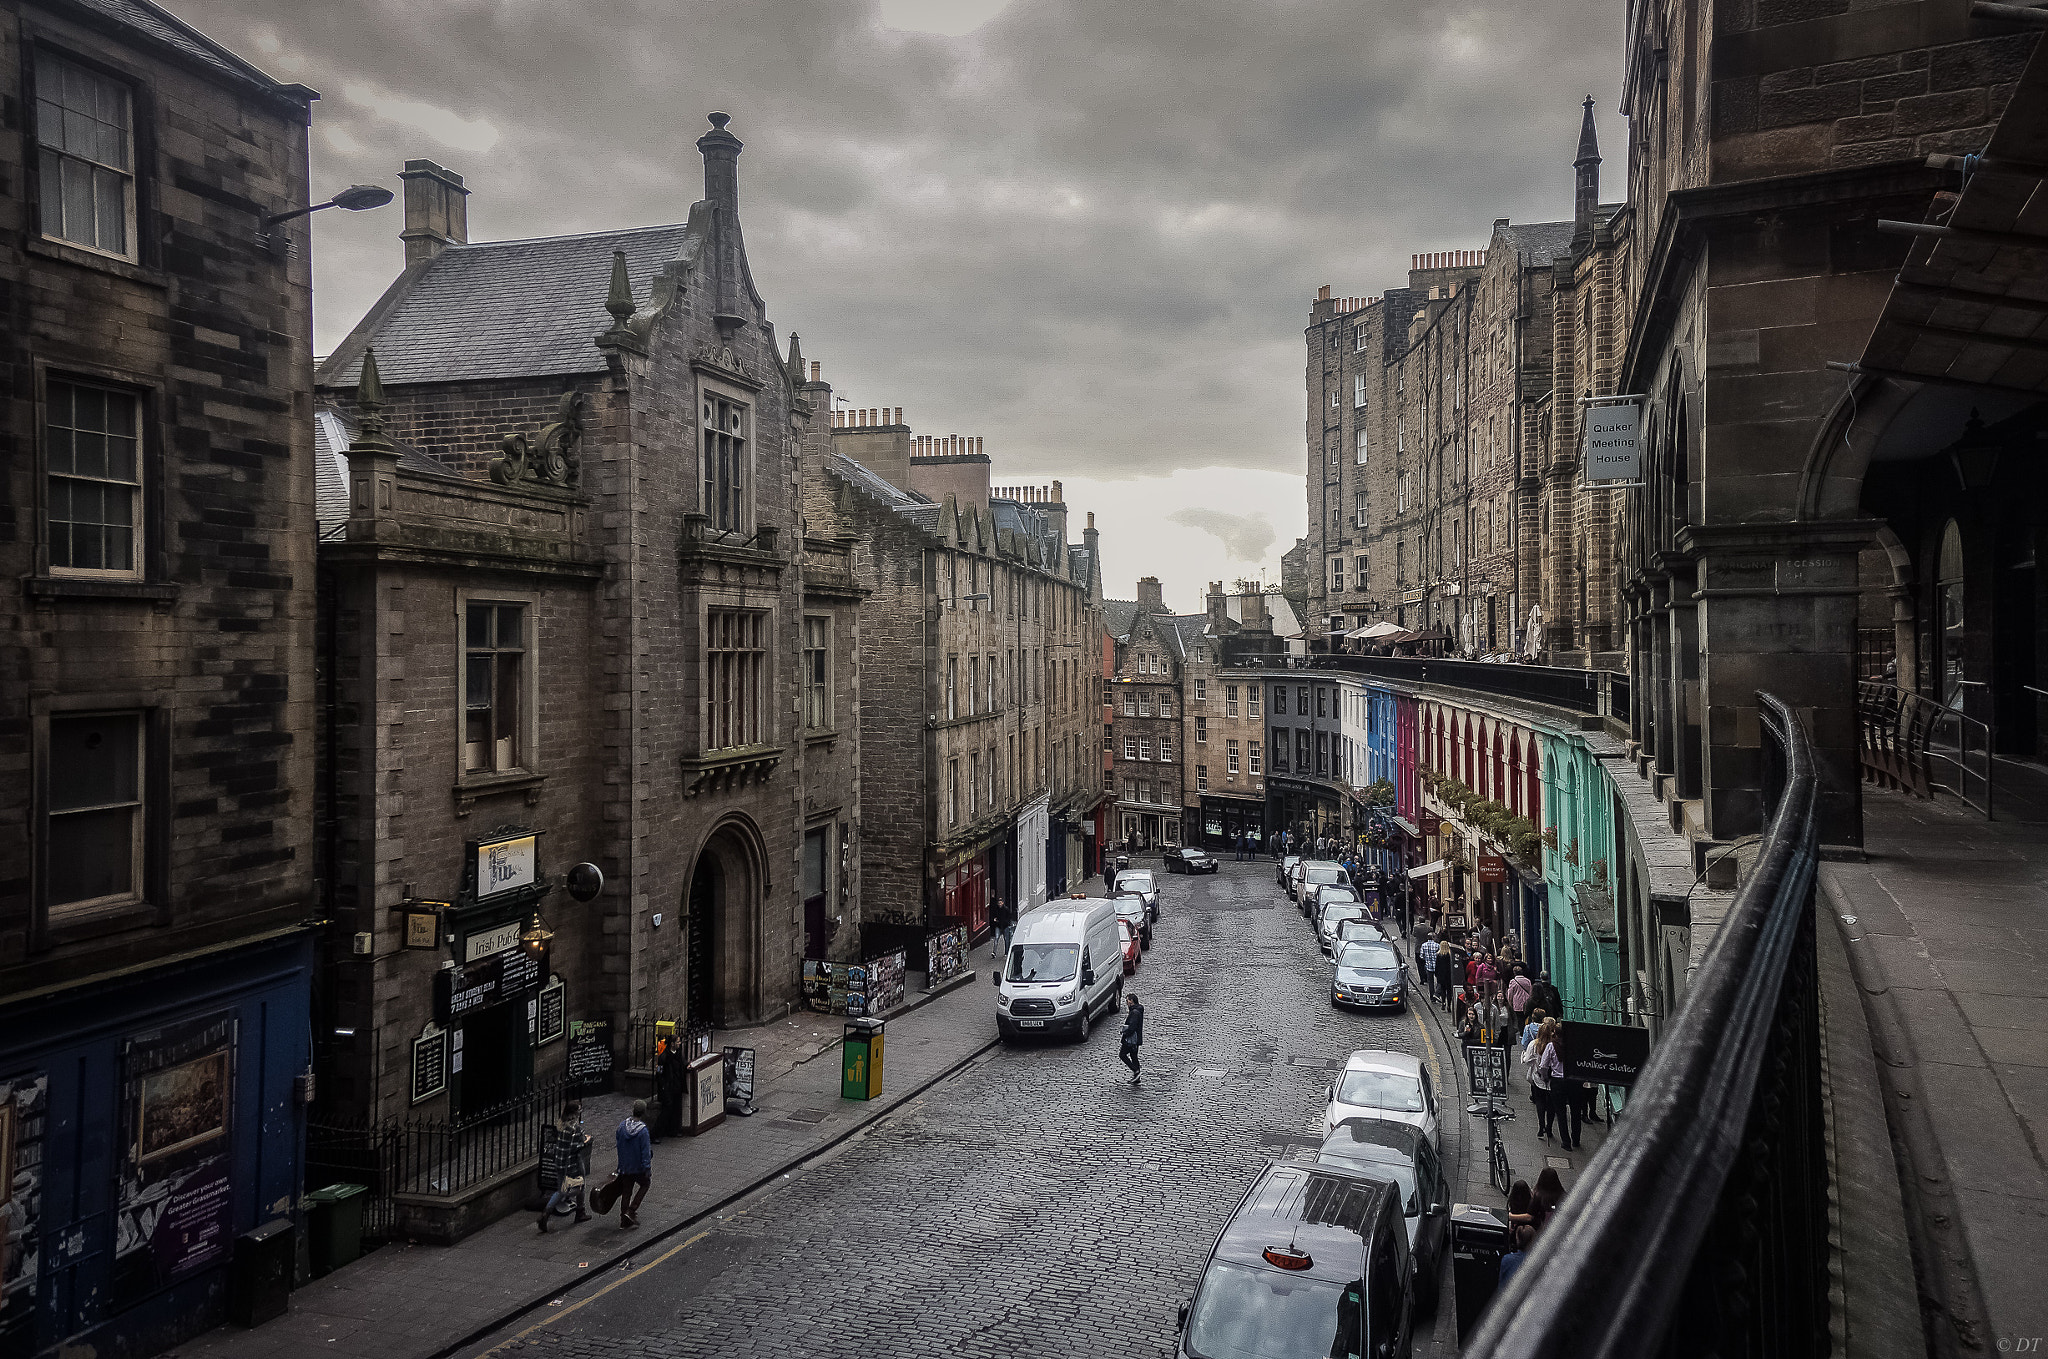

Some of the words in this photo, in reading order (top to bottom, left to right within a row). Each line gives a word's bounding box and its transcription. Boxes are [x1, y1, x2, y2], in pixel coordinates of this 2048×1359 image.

[1593, 423, 1633, 433] Quaker
[1592, 438, 1634, 449] Meeting
[1596, 455, 1631, 464] House
[475, 937, 494, 955] Irish
[497, 933, 512, 949] Pub
[451, 990, 465, 1004] GREAT
[465, 984, 483, 999] STUDENT
[450, 1003, 456, 1014] 7
[456, 1000, 468, 1012] DAYS
[467, 998, 473, 1008] A
[736, 1061, 753, 1069] TESTS
[1576, 1060, 1608, 1070] Walker
[1609, 1063, 1637, 1073] Slater
[173, 1187, 200, 1204] Discover
[200, 1181, 215, 1194] your
[214, 1176, 228, 1187] own
[167, 1200, 192, 1215] Greater
